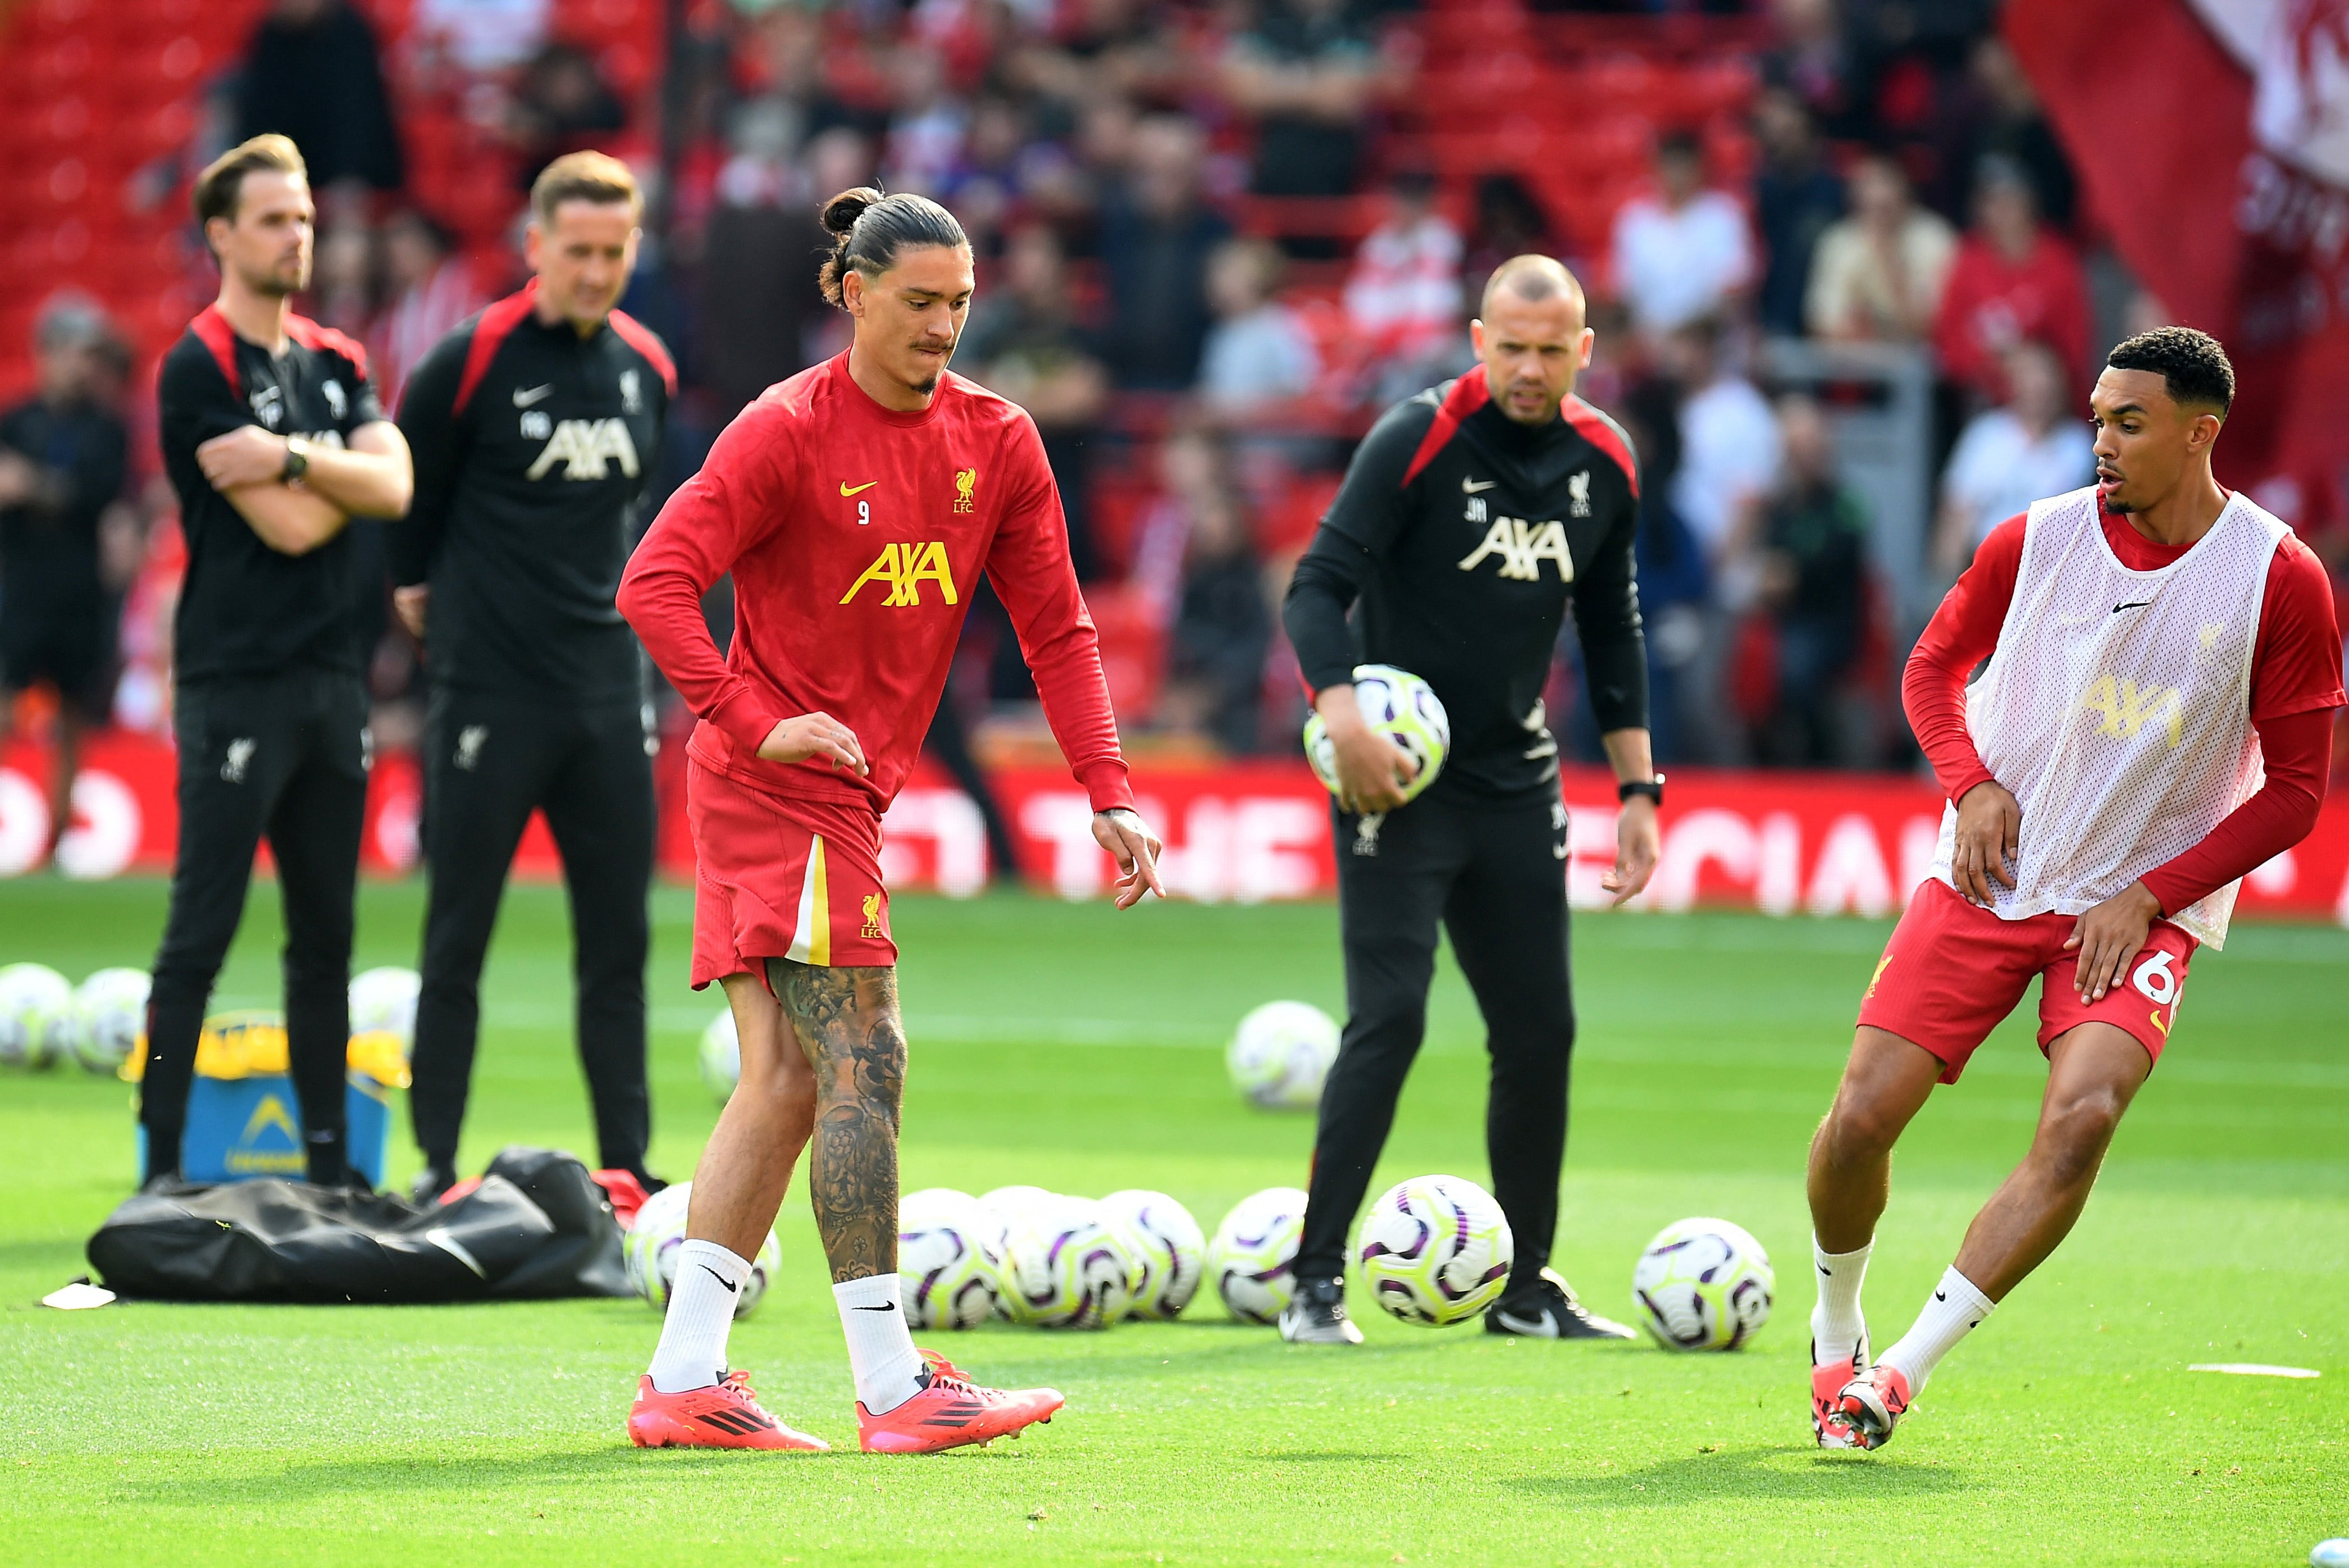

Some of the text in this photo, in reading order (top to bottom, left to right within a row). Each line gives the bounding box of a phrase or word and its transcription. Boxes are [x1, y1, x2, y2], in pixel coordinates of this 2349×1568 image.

[525, 417, 640, 481] AXA
[858, 500, 870, 525] 9
[839, 541, 958, 607] AXA
[1457, 516, 1575, 584] AXA
